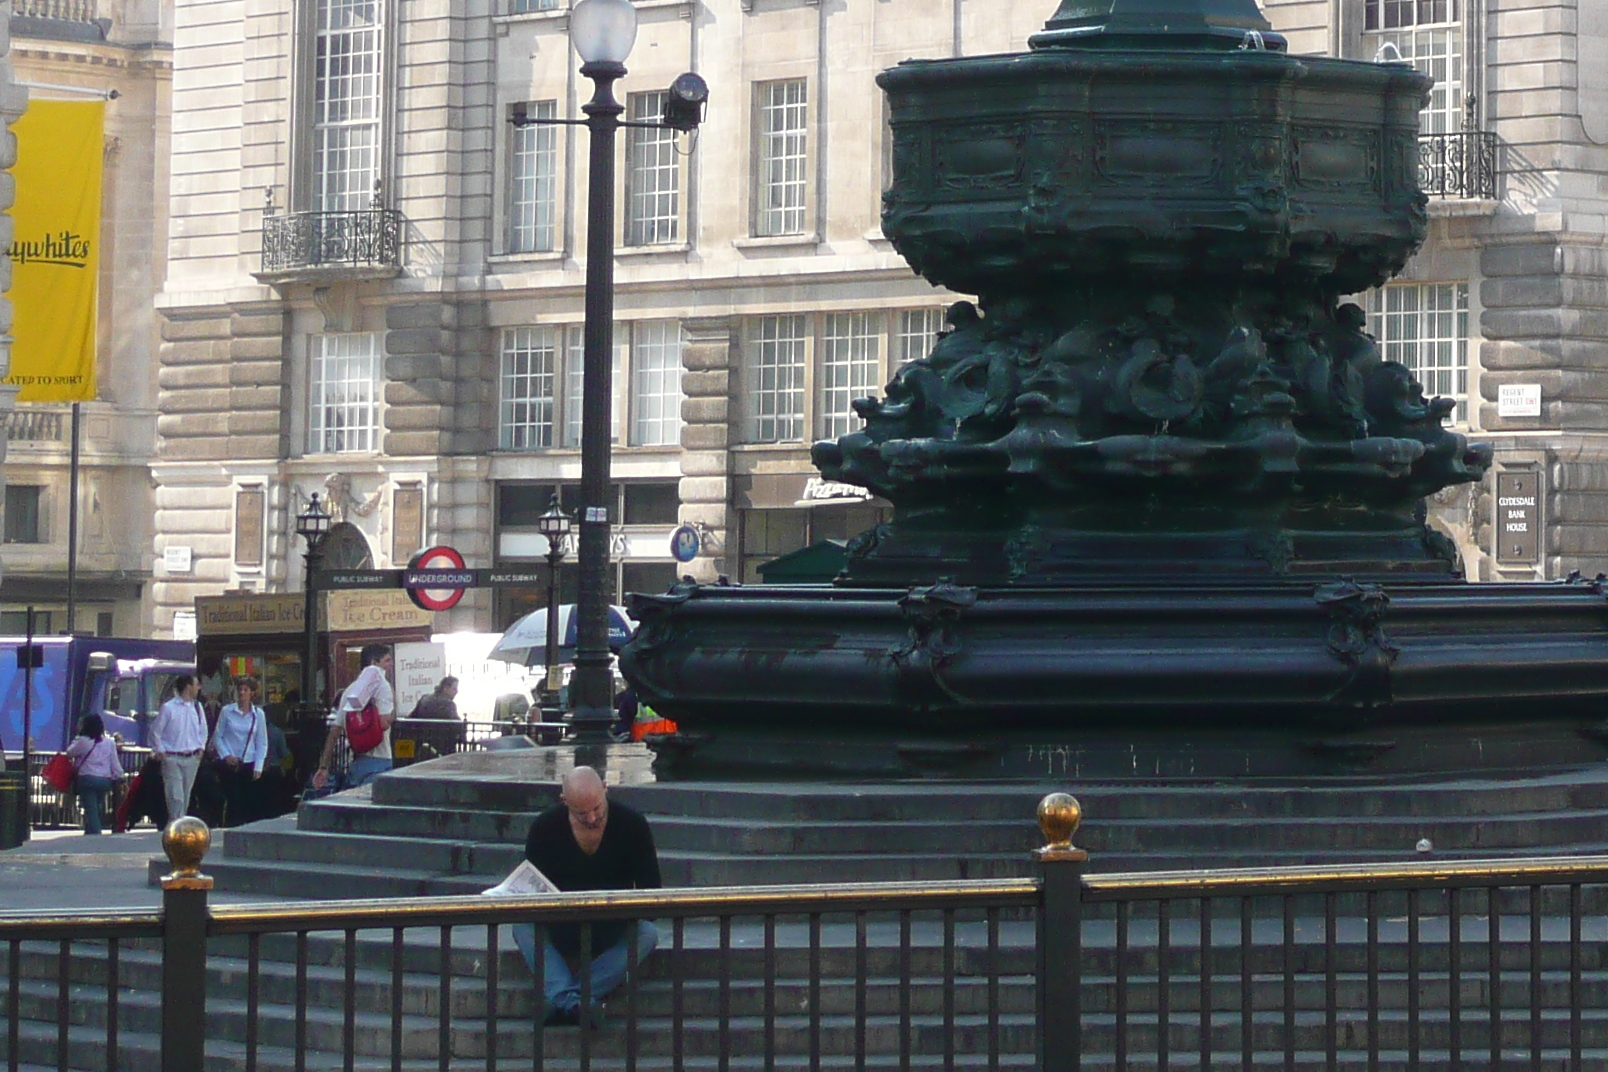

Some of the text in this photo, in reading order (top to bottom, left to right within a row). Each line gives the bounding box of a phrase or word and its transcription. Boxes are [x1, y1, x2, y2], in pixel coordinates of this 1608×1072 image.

[1502, 389, 1525, 397] REGENT
[1502, 398, 1523, 406] STREET
[1499, 497, 1535, 506] CLYDESDALE
[1508, 510, 1526, 518] BANK
[1506, 523, 1528, 532] HOUSE
[333, 575, 384, 584] PUBLIC SUBWAY
[408, 574, 473, 584] UNDERGROUND
[489, 574, 538, 583] PUBLIC SUBWAY
[201, 605, 248, 625] Traditional
[249, 604, 276, 622] Italian
[278, 602, 292, 621] Ice
[341, 606, 419, 624] Ice Cream
[400, 656, 441, 671] Traditional
[408, 674, 433, 687] Italian
[401, 691, 414, 704] Ice
